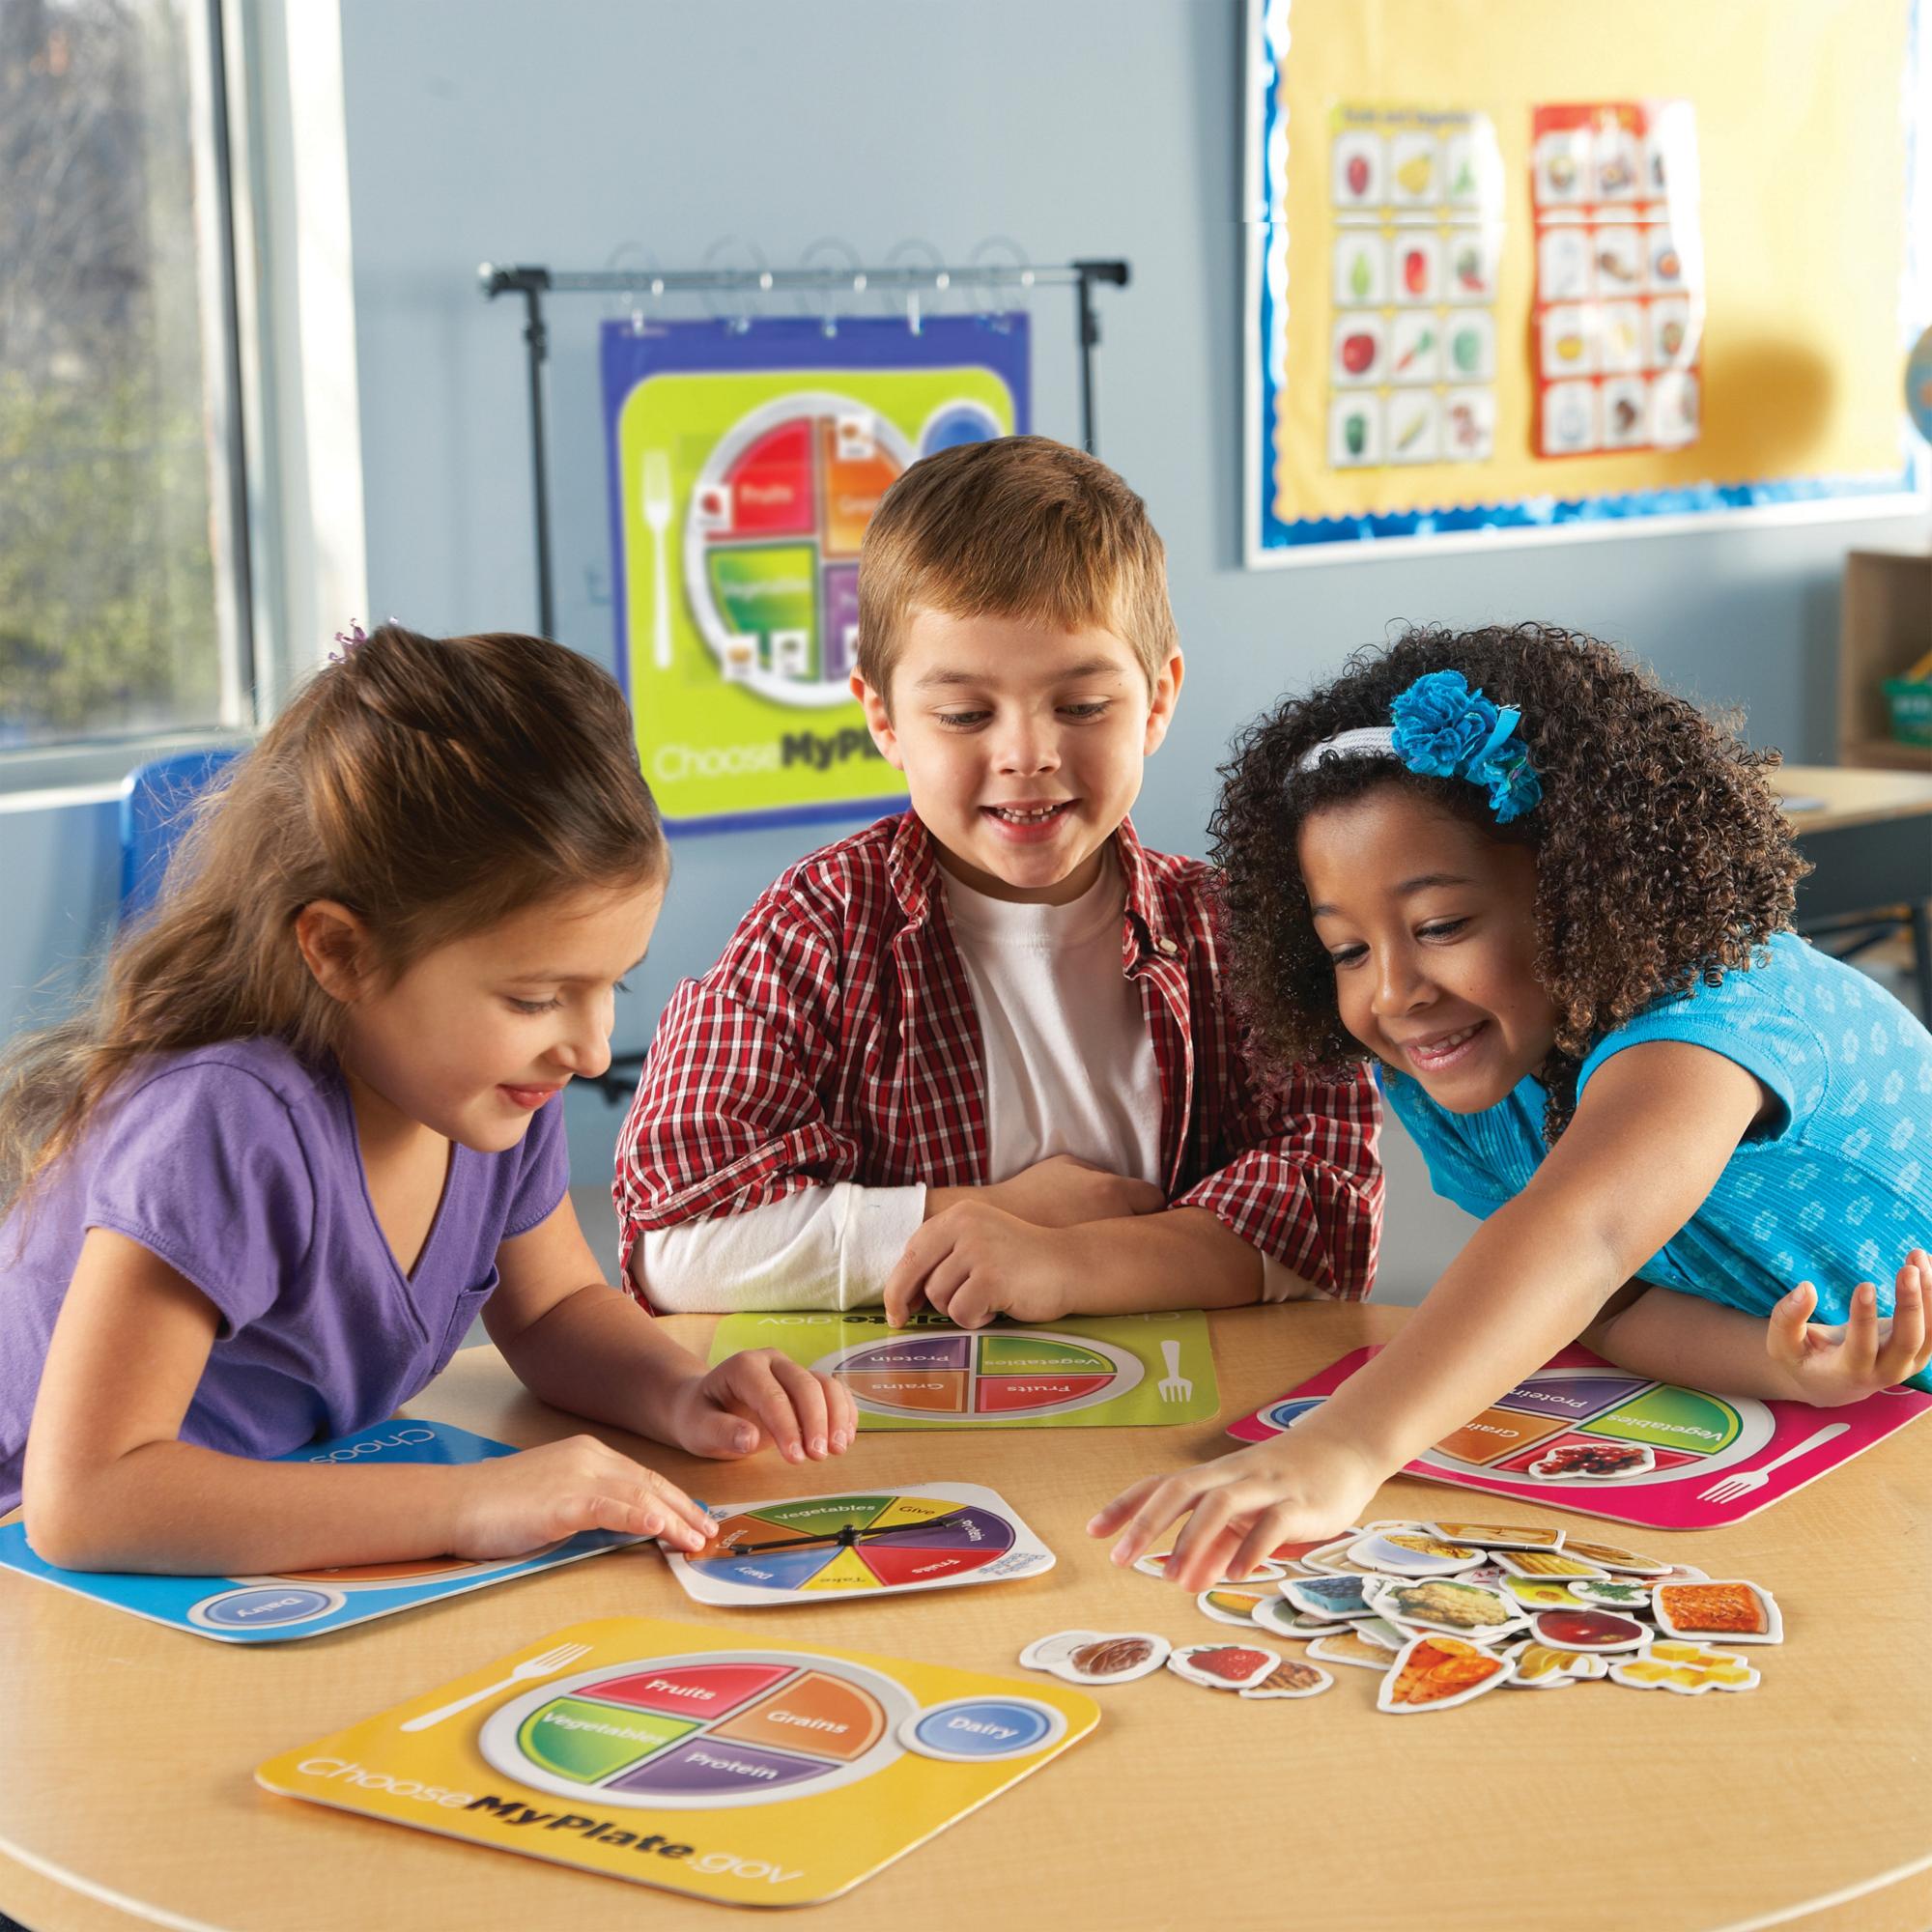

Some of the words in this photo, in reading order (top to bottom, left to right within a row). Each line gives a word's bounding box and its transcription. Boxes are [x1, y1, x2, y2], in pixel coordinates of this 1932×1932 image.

[1466, 1423, 1520, 1438] Grai
[1606, 1413, 1723, 1441] Vegetables
[774, 1505, 875, 1520] Vegetables
[899, 1506, 935, 1516] Give
[734, 1567, 774, 1579] Dairy
[912, 1559, 961, 1574] Fruits
[237, 1597, 304, 1618] Dairy
[644, 1679, 717, 1701] Fruits
[542, 1712, 669, 1746] Vegetables
[767, 1710, 850, 1735] Grains
[948, 1716, 1019, 1740] Dairy
[685, 1751, 779, 1780] Protein
